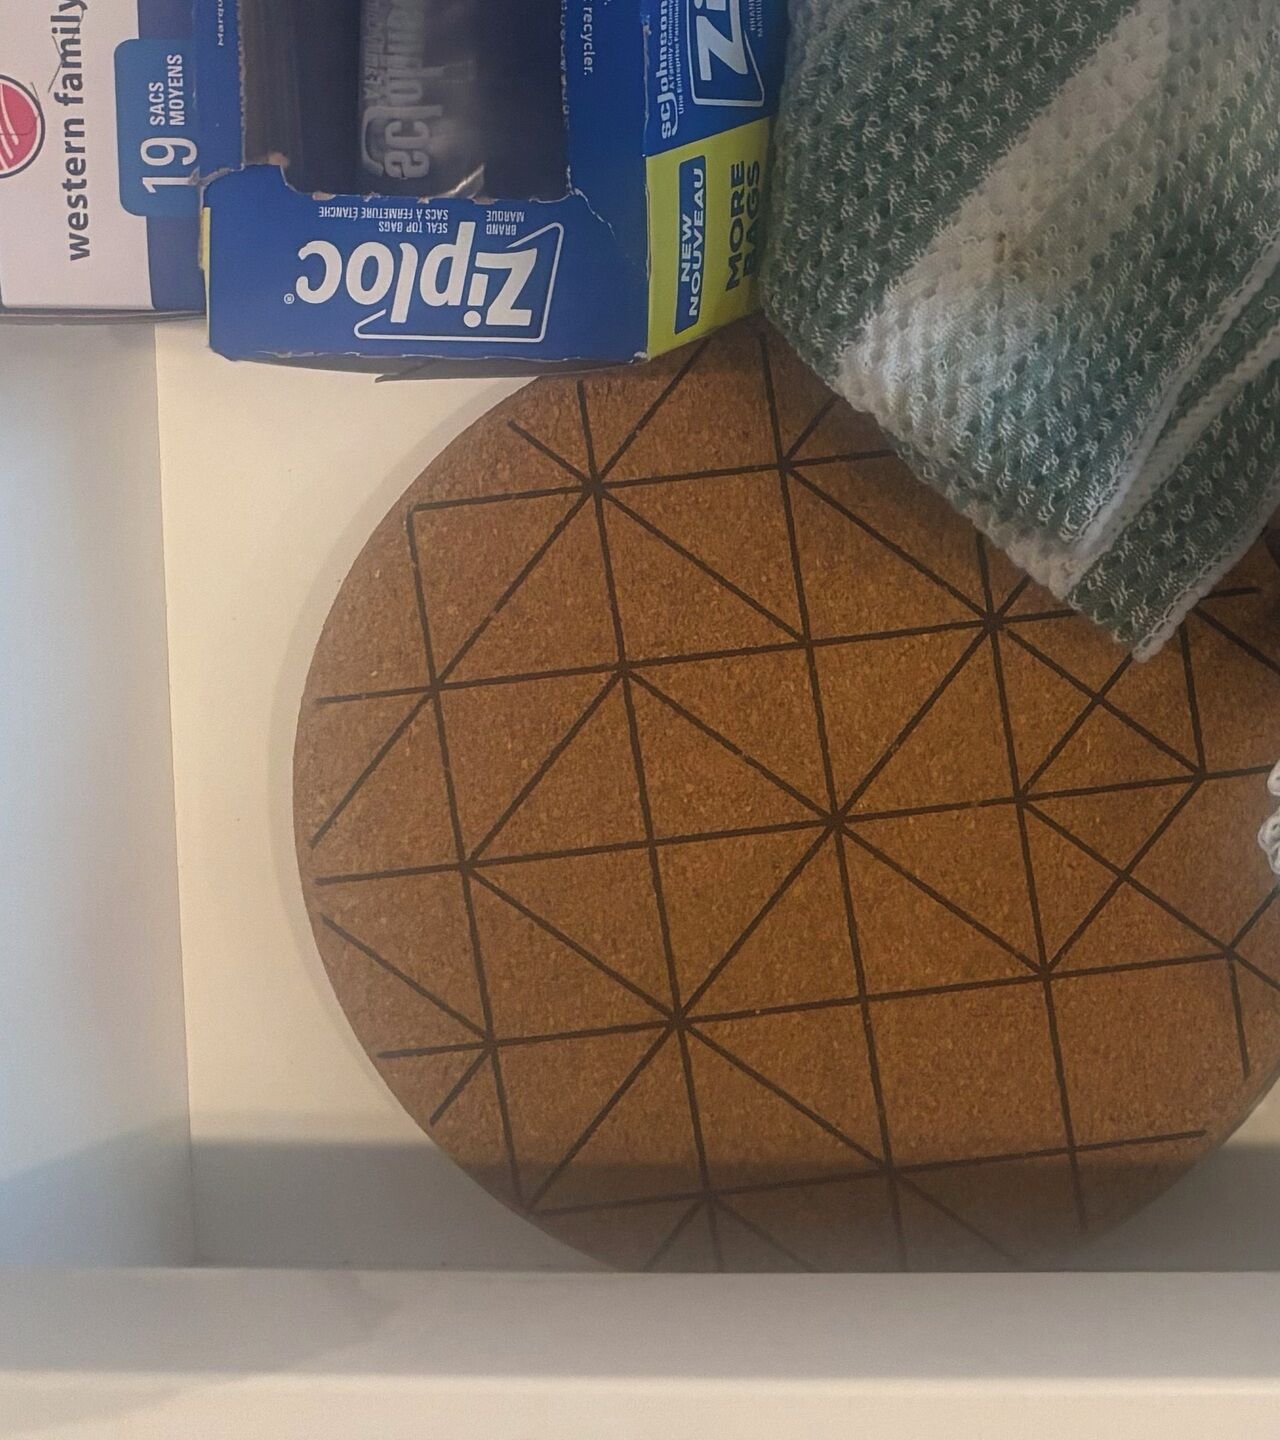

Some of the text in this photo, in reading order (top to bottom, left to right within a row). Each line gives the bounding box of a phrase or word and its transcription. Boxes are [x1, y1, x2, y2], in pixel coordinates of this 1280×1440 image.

[579, 6, 597, 76] recycler.
[148, 82, 165, 126] SACS
[166, 54, 186, 126] MOYENS
[60, 118, 90, 261] western
[140, 136, 198, 194] 19
[360, 207, 413, 219] FERMETURE
[378, 220, 449, 234] SEAL TOP BAGS
[423, 208, 449, 220] SACS
[486, 209, 525, 222] MARQUE
[486, 223, 517, 235] BRAND
[689, 168, 704, 316] NOUVEAU
[725, 161, 744, 292] MORE
[295, 221, 537, 328] Ziploc
[681, 215, 692, 282] NEW
